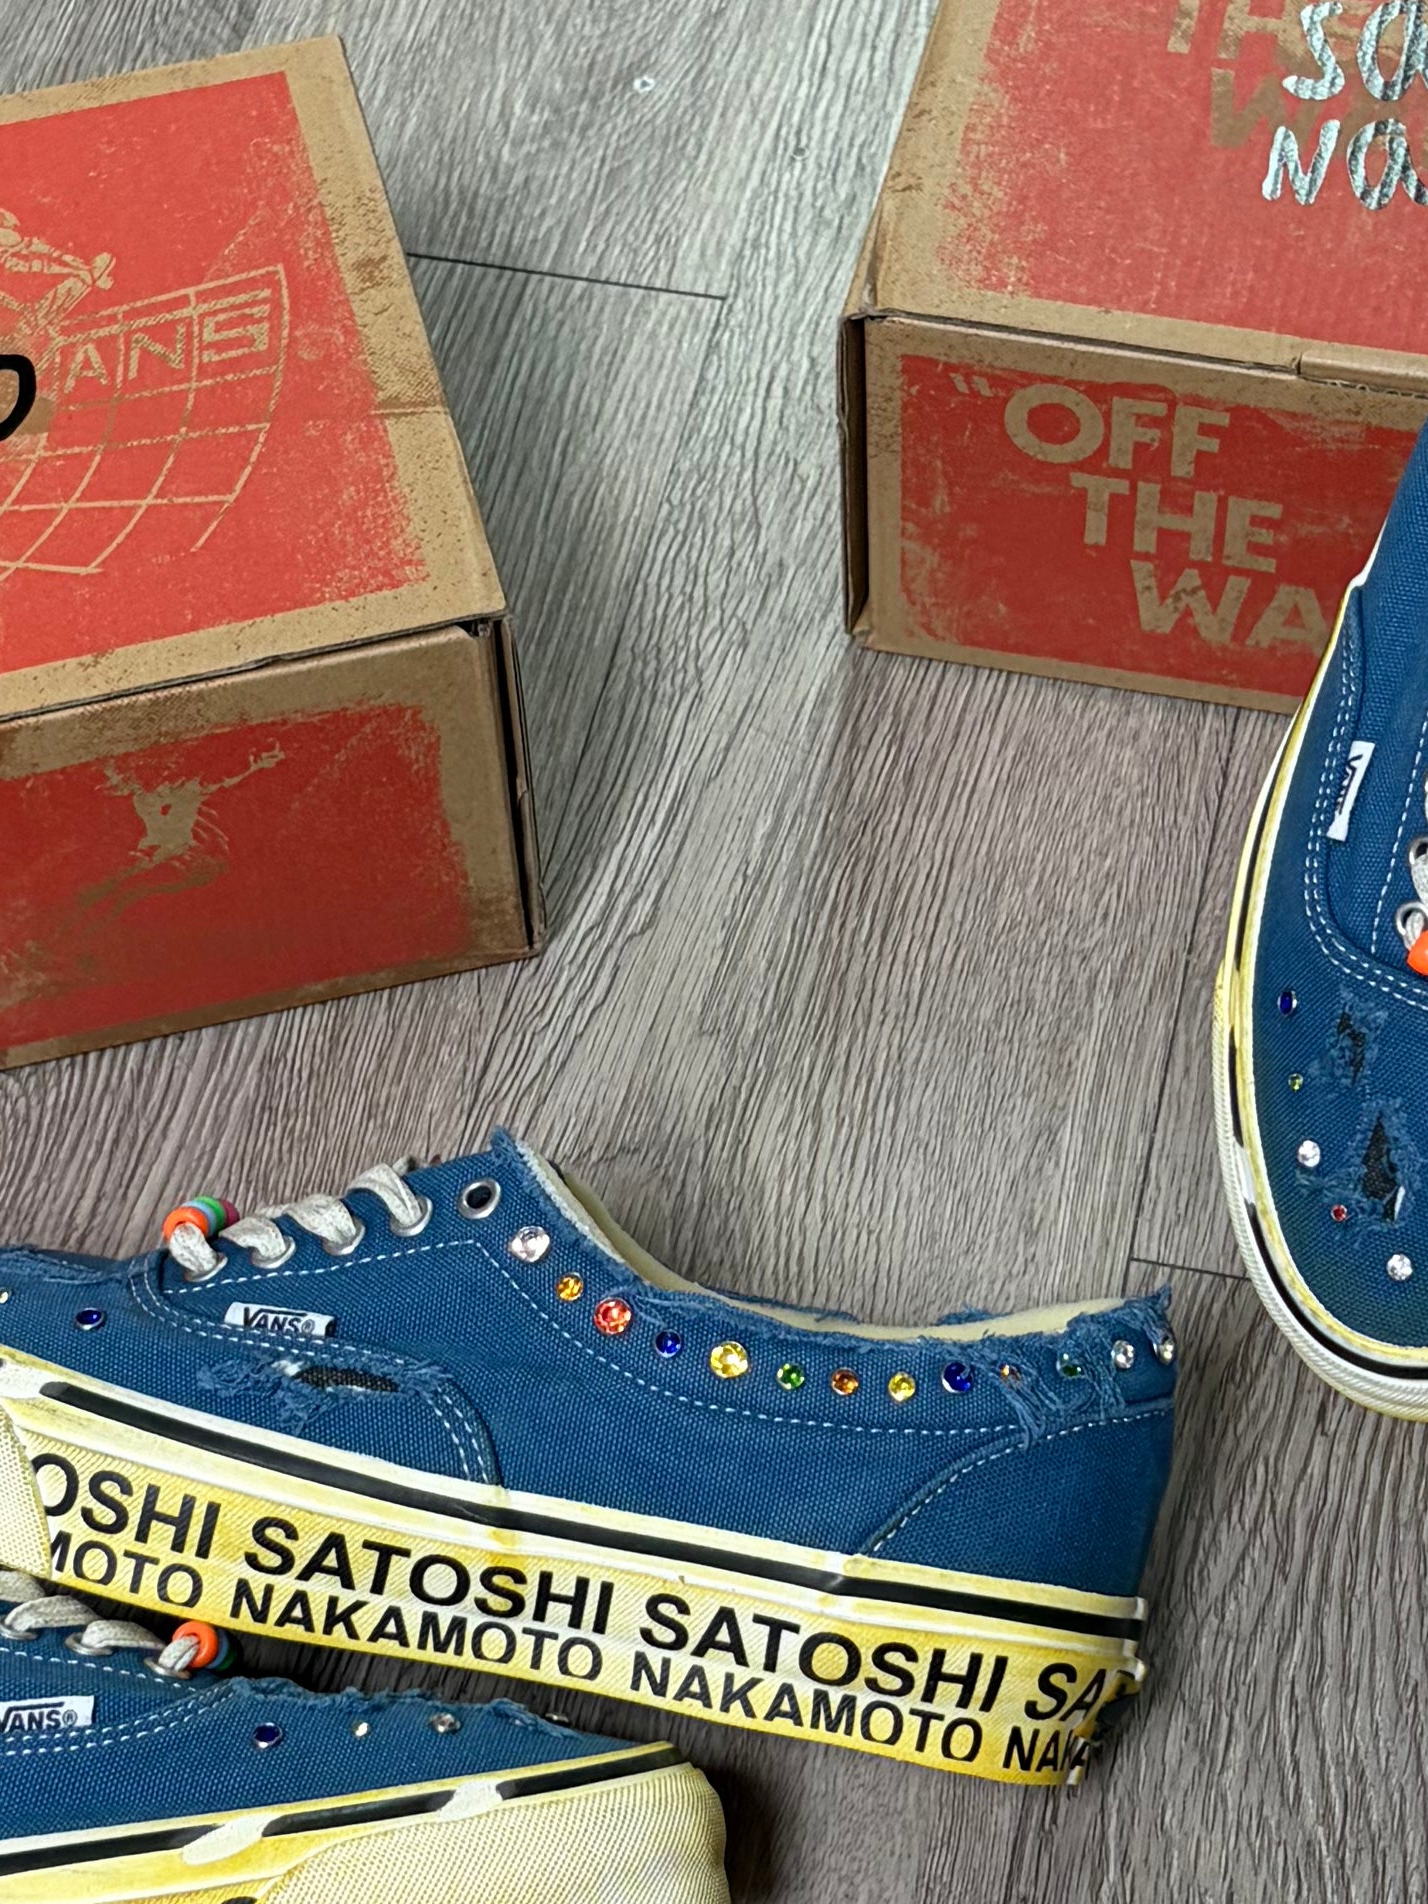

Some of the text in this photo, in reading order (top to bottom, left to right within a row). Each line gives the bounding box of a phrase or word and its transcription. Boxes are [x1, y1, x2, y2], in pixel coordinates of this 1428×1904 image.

[62, 289, 273, 395] ANS
[1070, 472, 1283, 574] THE
[229, 1577, 603, 1681] NAKAMOTO
[629, 1650, 984, 1762] NAKAMOTO
[243, 1516, 615, 1636] SATOSHI
[639, 1593, 1009, 1713] SATOSHI
